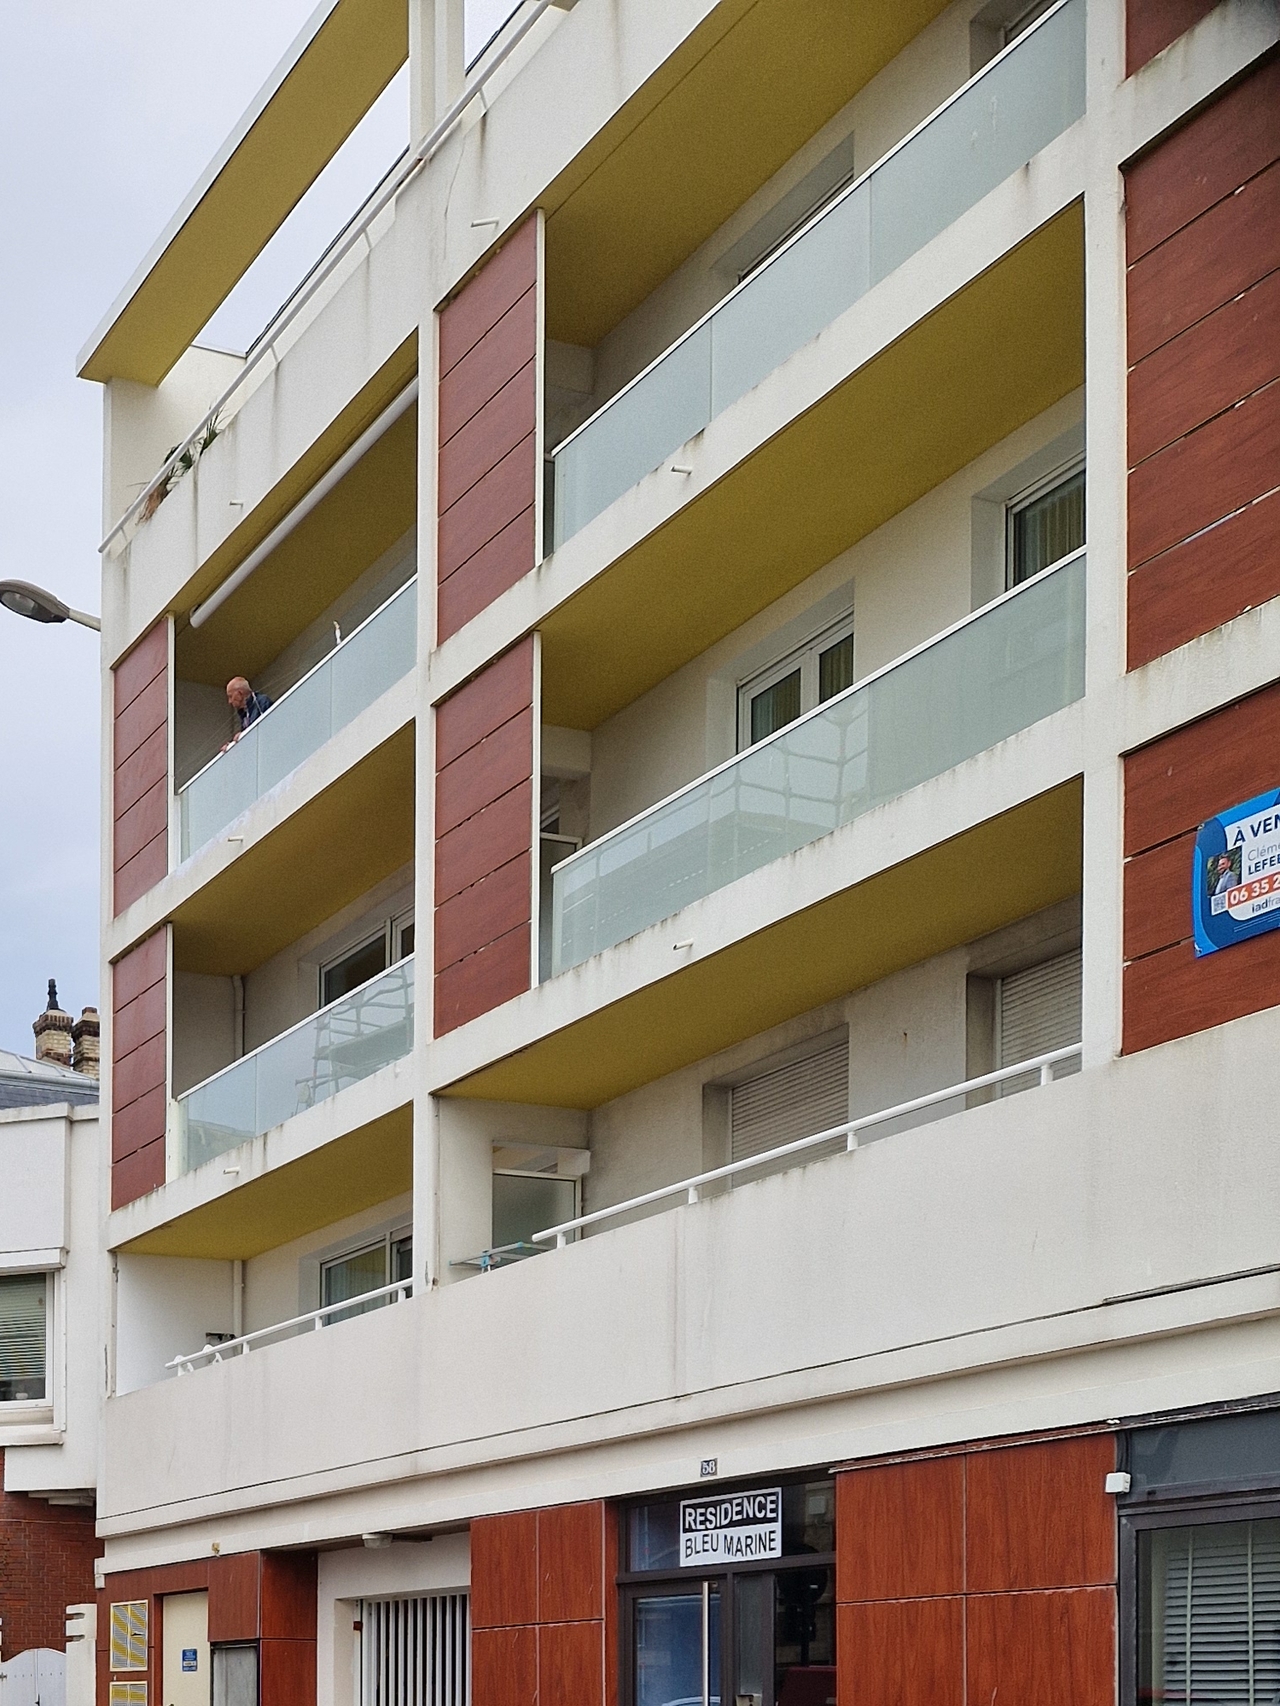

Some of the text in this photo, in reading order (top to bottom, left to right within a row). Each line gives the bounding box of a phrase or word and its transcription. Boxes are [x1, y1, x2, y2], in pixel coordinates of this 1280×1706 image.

[1233, 826, 1246, 846] À
[1247, 842, 1280, 861] Clém
[1230, 887, 1249, 905] 06
[1251, 879, 1270, 897] 35
[702, 1460, 716, 1474] 58
[684, 1495, 777, 1530] RESIDENCE
[685, 1530, 777, 1559] BLEU MARINE
